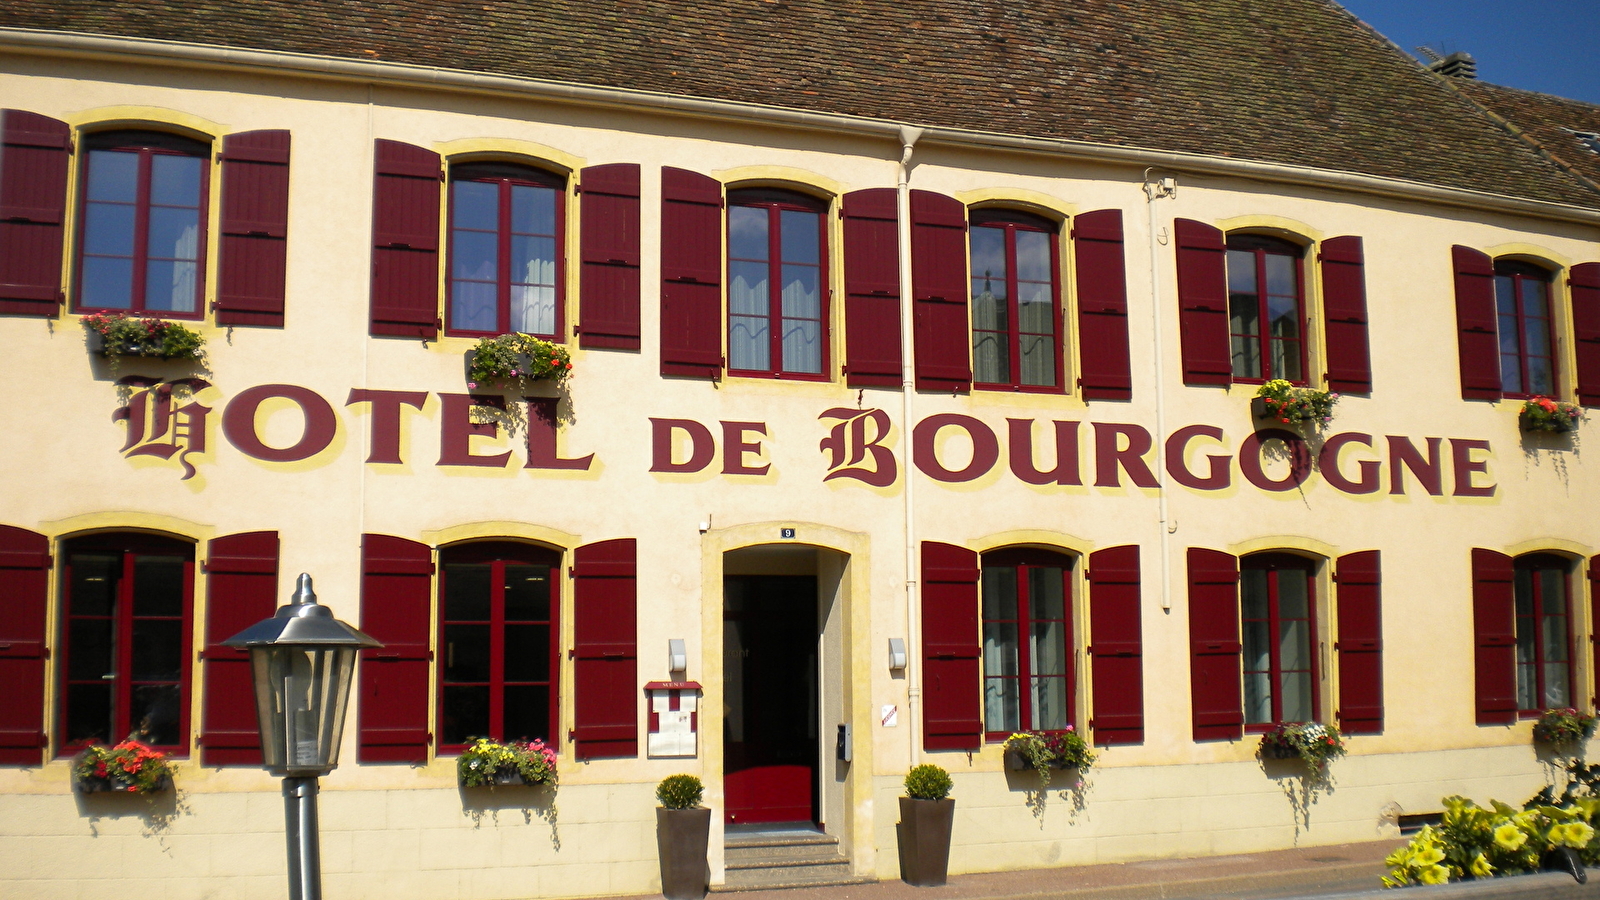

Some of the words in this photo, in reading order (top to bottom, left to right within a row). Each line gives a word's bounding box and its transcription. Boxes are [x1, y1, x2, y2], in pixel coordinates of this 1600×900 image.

[112, 374, 595, 481] HOTEL
[648, 417, 772, 476] DE
[818, 407, 1498, 498] BOURGOGNE
[785, 529, 791, 537] 9
